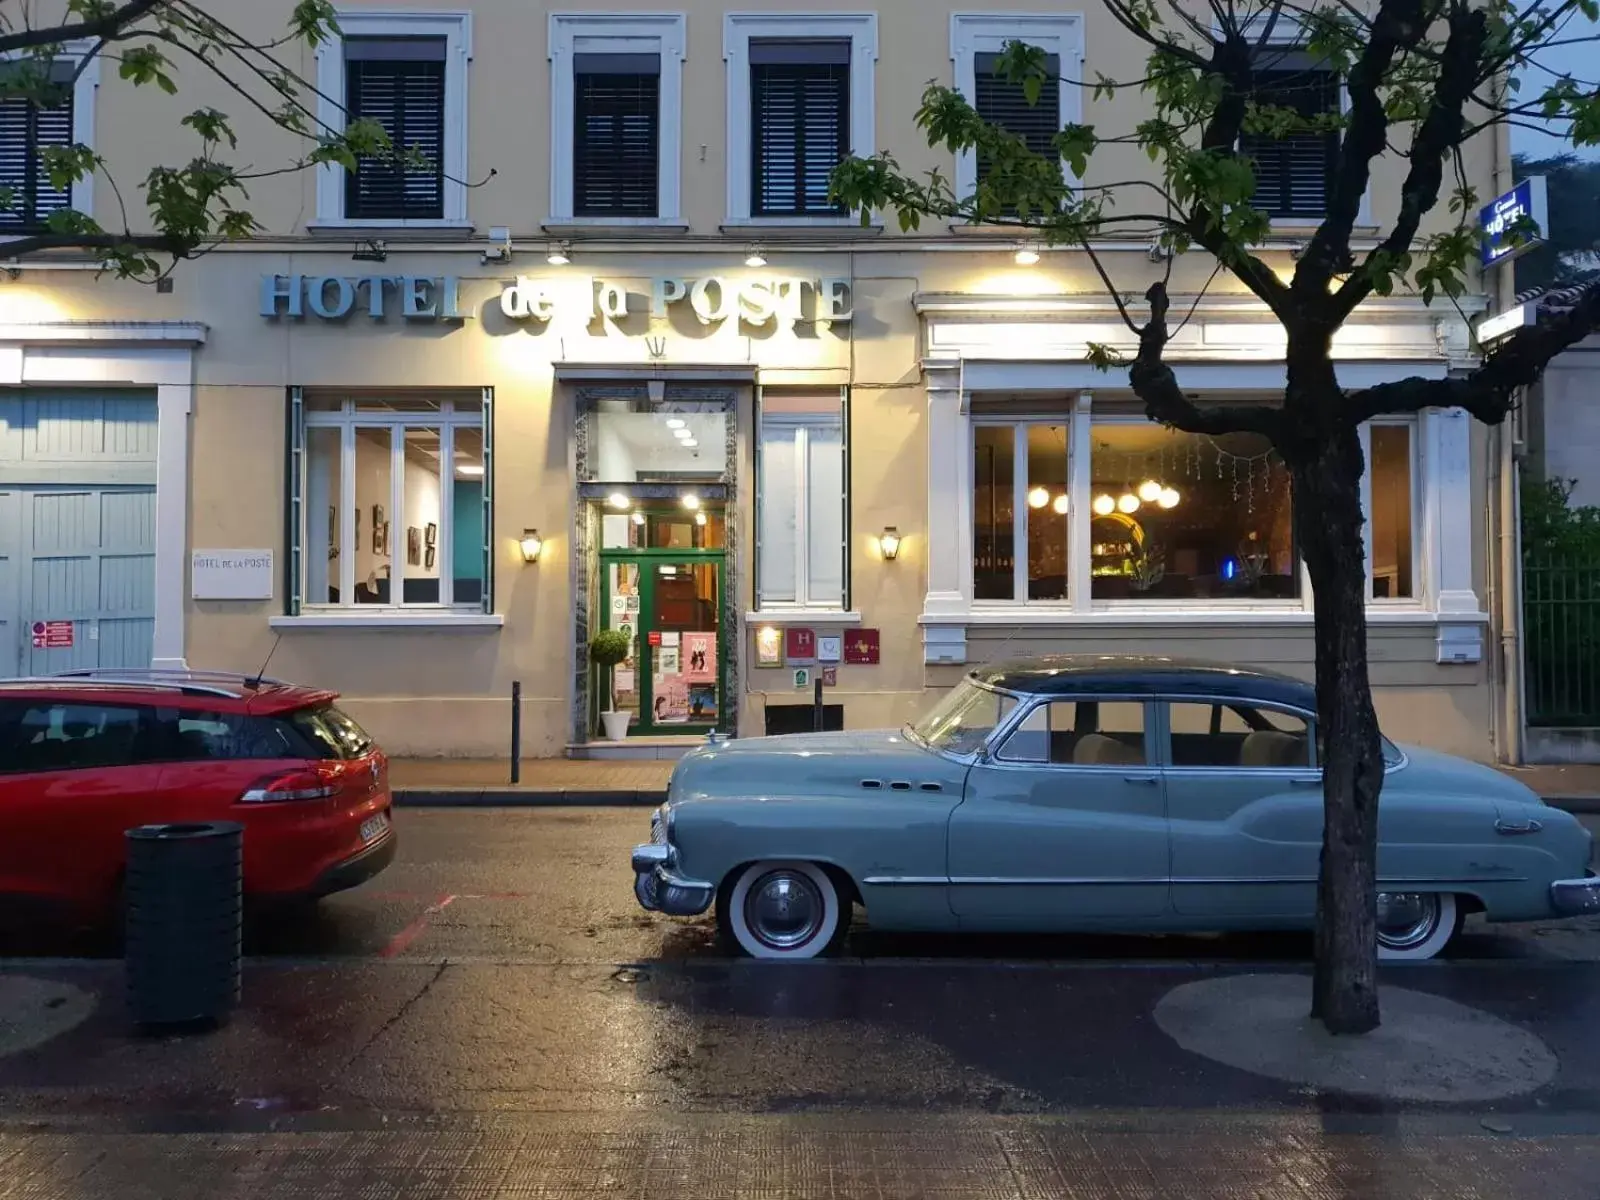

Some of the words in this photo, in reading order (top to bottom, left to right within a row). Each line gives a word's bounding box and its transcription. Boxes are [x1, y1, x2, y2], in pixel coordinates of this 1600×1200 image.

[260, 274, 476, 319] HOTEL
[501, 275, 553, 320] de
[574, 275, 629, 318] la
[652, 275, 853, 324] POSTE
[194, 558, 220, 569] HOTEL
[244, 558, 272, 569] POSTE
[798, 632, 811, 645] H
